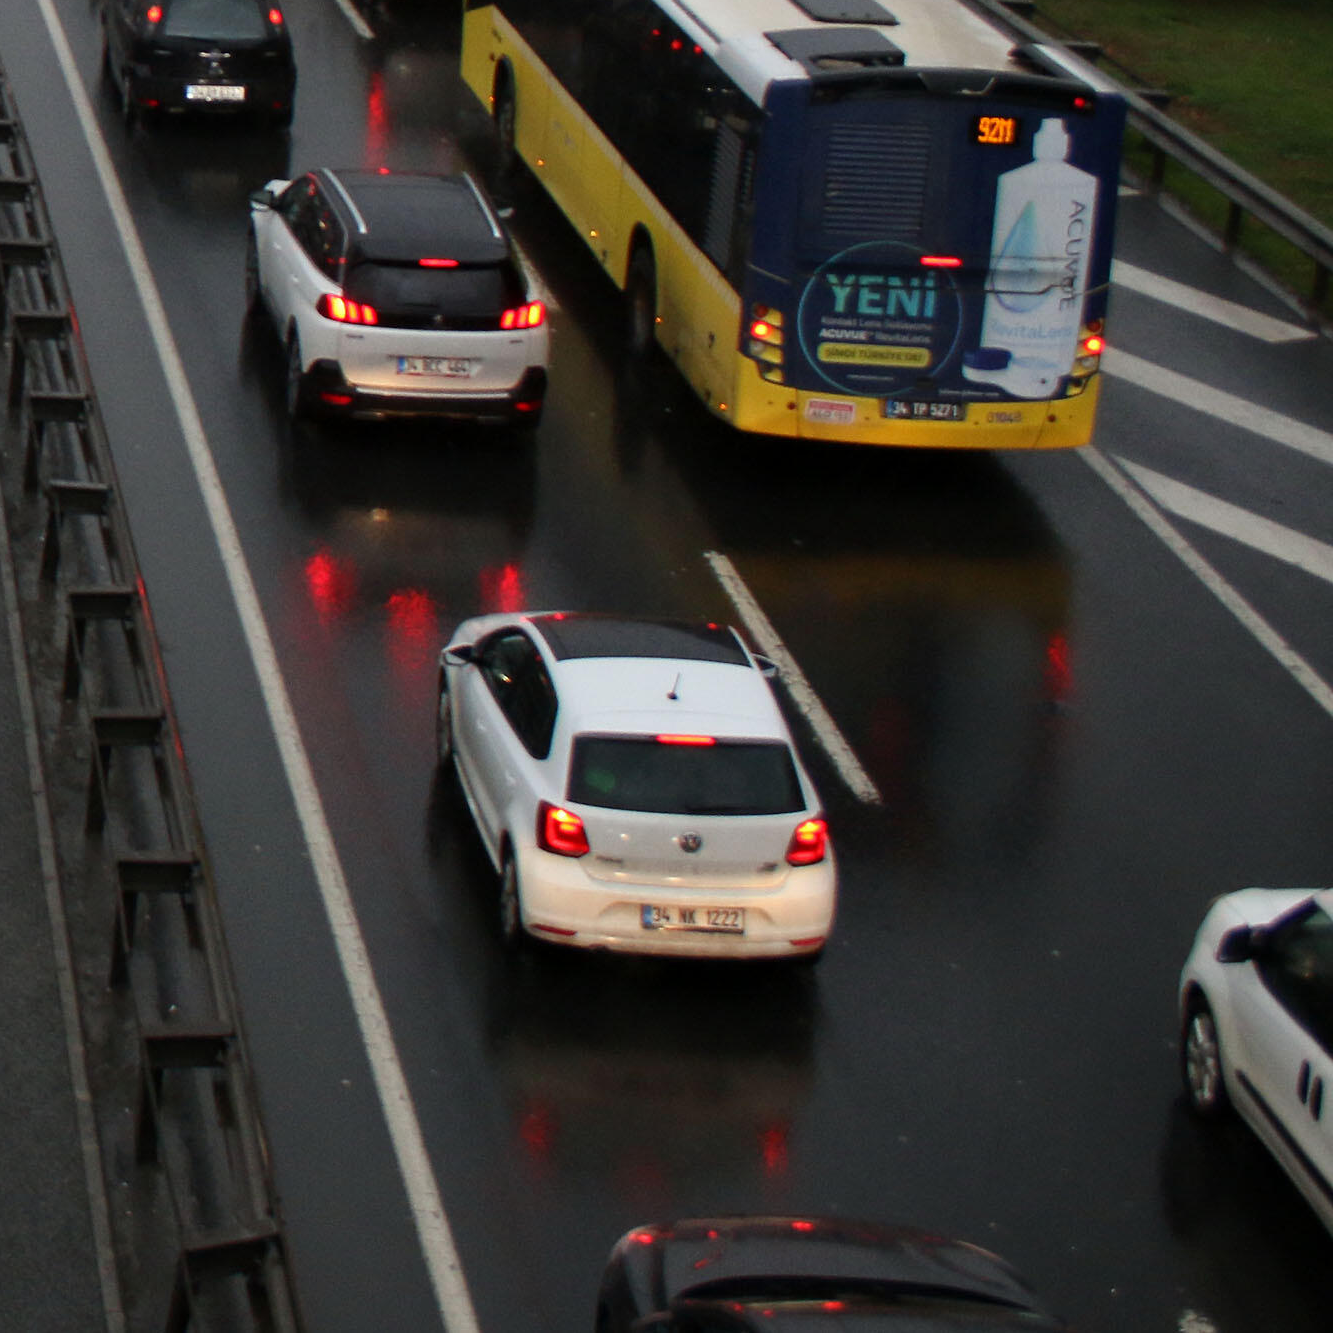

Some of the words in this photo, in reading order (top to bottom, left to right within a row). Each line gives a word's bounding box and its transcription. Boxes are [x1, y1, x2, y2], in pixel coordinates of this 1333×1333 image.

[977, 116, 1016, 144] 92M
[825, 270, 937, 318] YENİ
[892, 402, 907, 415] 34
[930, 404, 958, 417] 5271
[652, 906, 671, 922] 34
[706, 909, 740, 927] 1222
